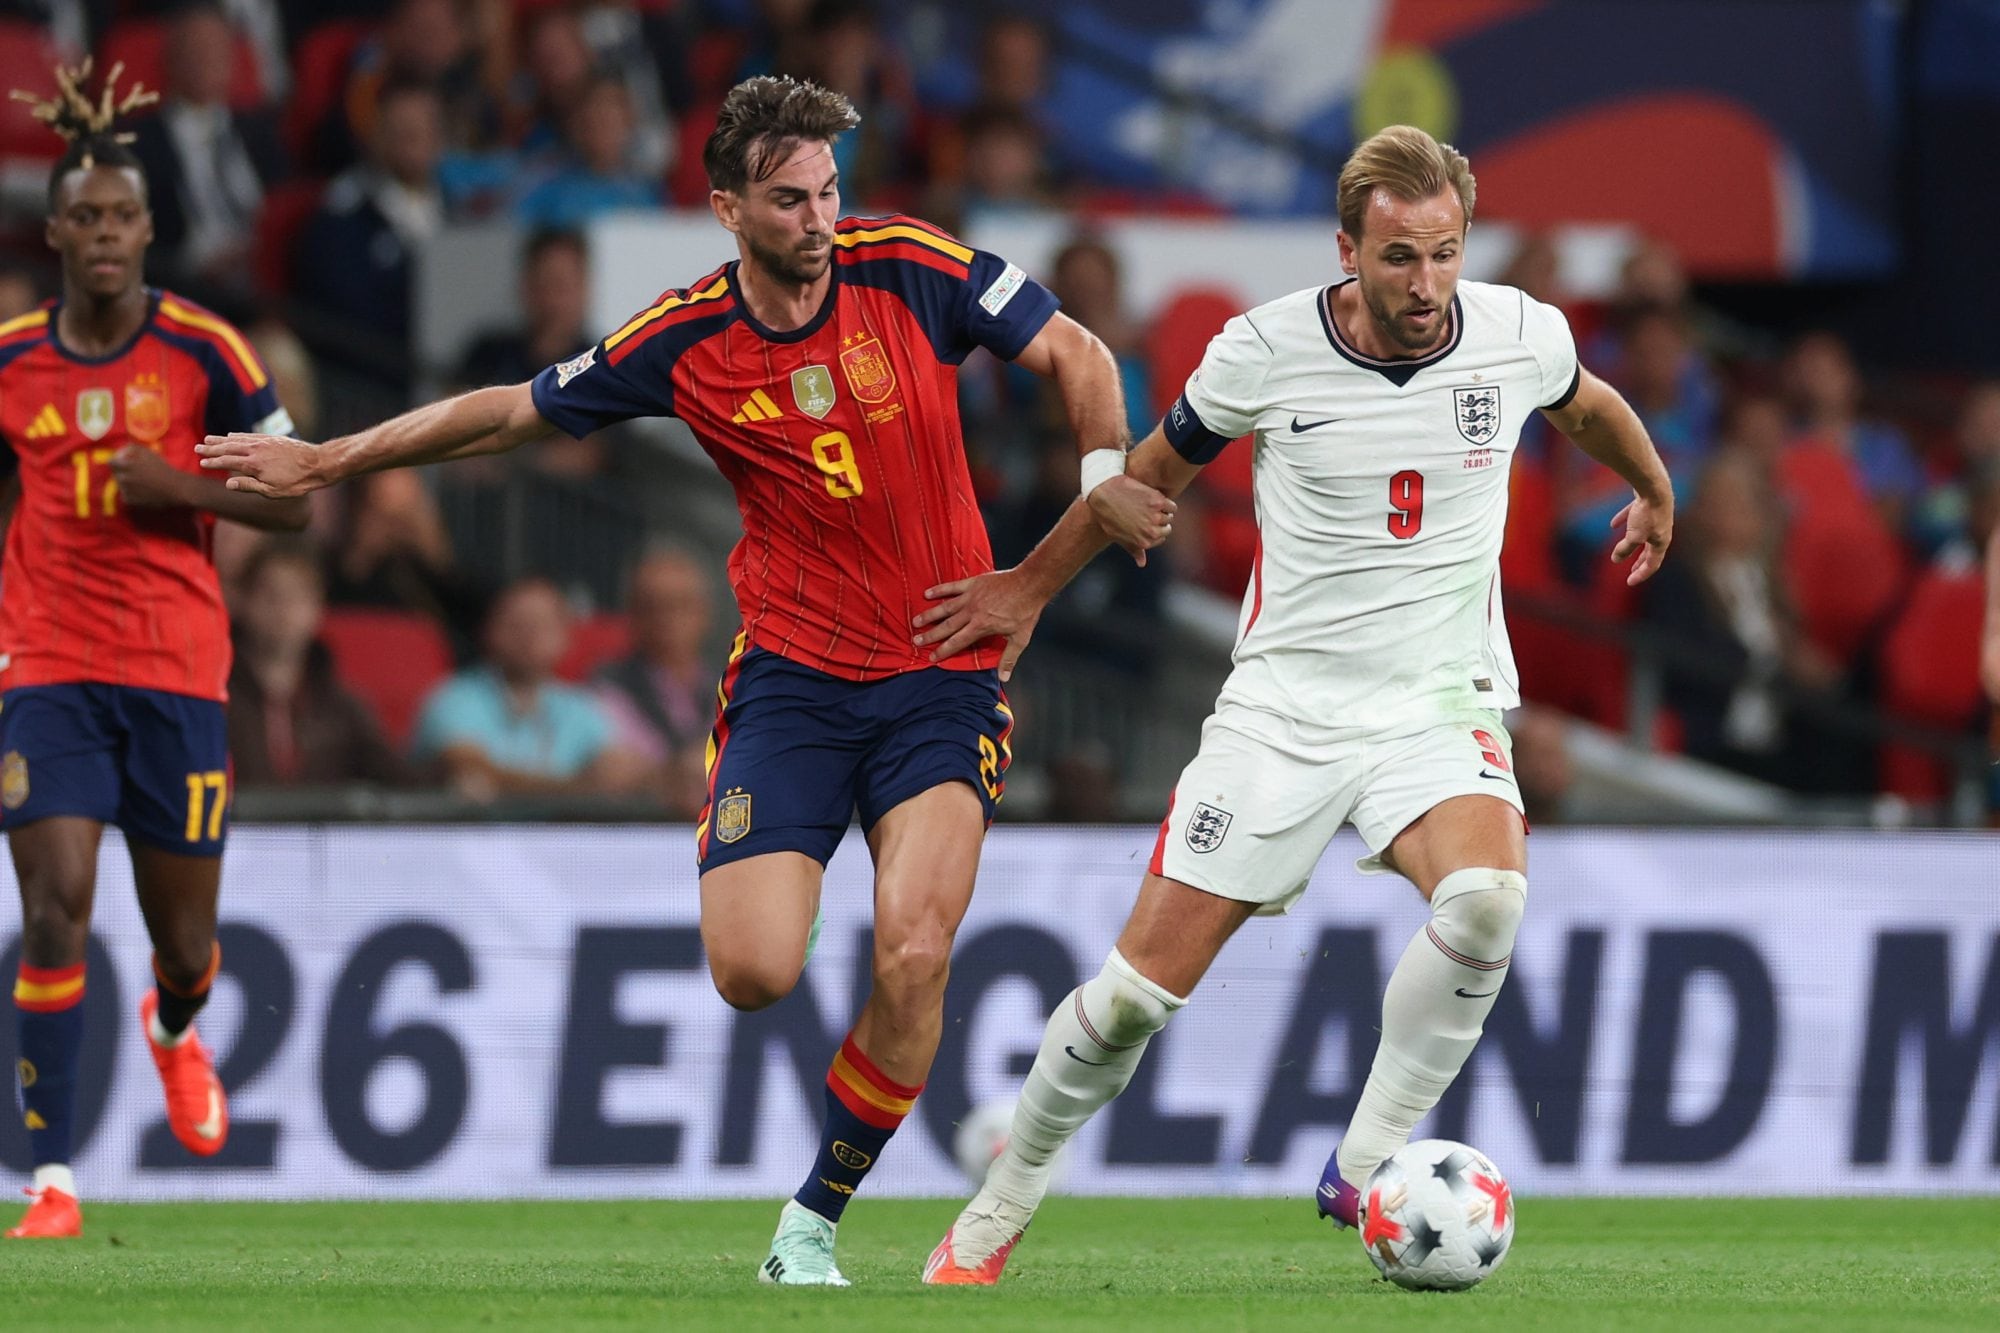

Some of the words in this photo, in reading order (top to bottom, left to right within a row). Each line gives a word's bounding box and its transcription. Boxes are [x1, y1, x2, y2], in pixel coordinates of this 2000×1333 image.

[1468, 448, 1492, 456] SPAIN
[1387, 470, 1424, 540] 9
[1471, 729, 1511, 773] 9
[185, 770, 226, 842] 17
[548, 922, 1779, 1167] ENGLAND
